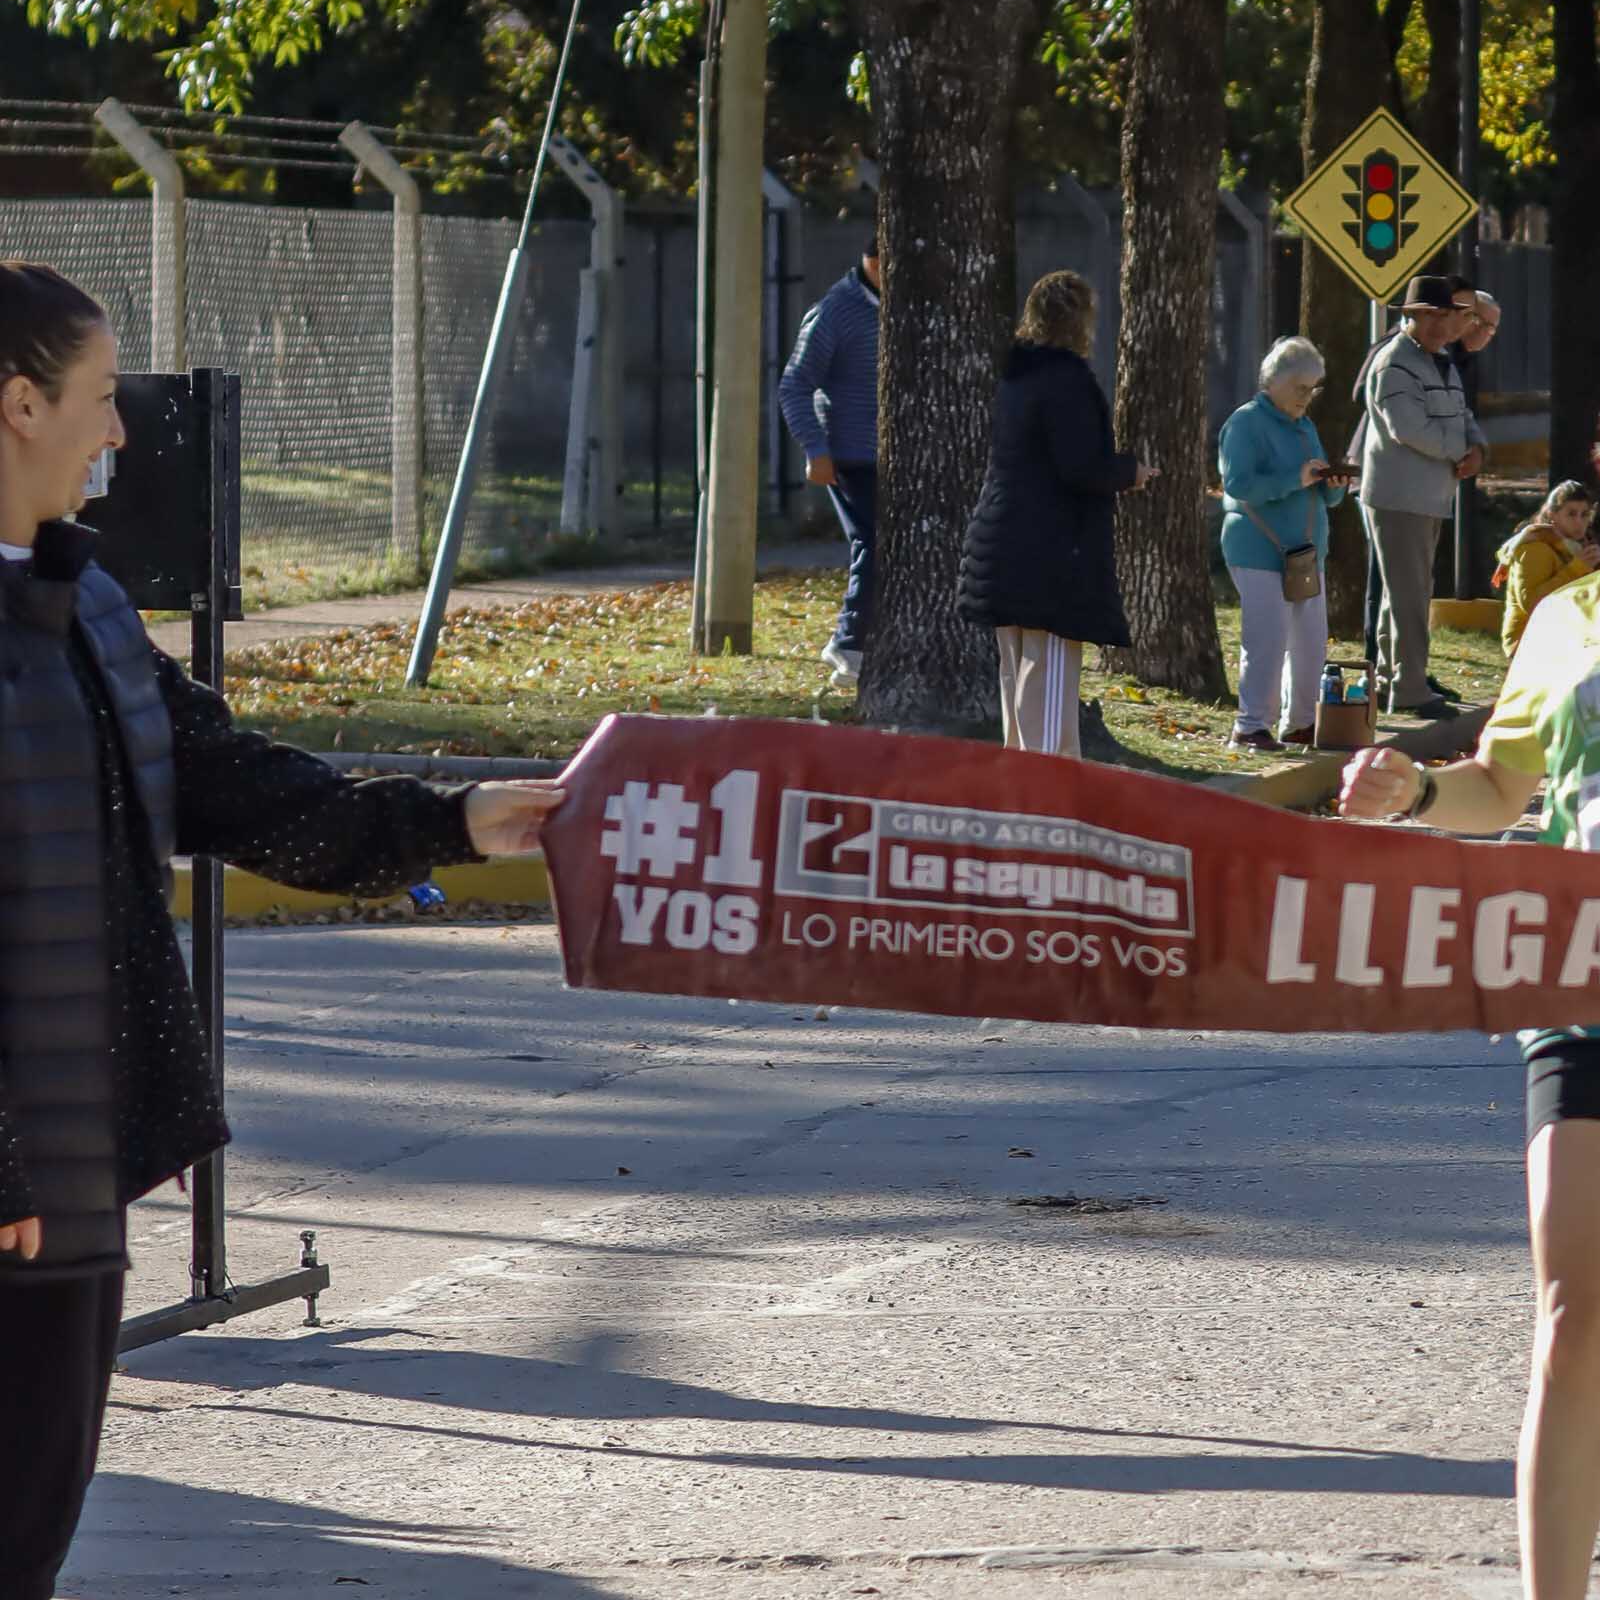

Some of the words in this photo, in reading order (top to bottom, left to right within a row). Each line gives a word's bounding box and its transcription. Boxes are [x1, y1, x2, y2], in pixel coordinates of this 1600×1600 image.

[600, 768, 763, 888] #1
[892, 812, 987, 838] GRUPO
[995, 823, 1177, 871] ASEGURADOR
[612, 883, 761, 956] VOS
[952, 856, 1179, 922] segunda
[782, 910, 837, 948] LO
[848, 916, 1016, 961] PRIMERO
[1025, 929, 1101, 968] SOS
[1111, 935, 1188, 978] VOS
